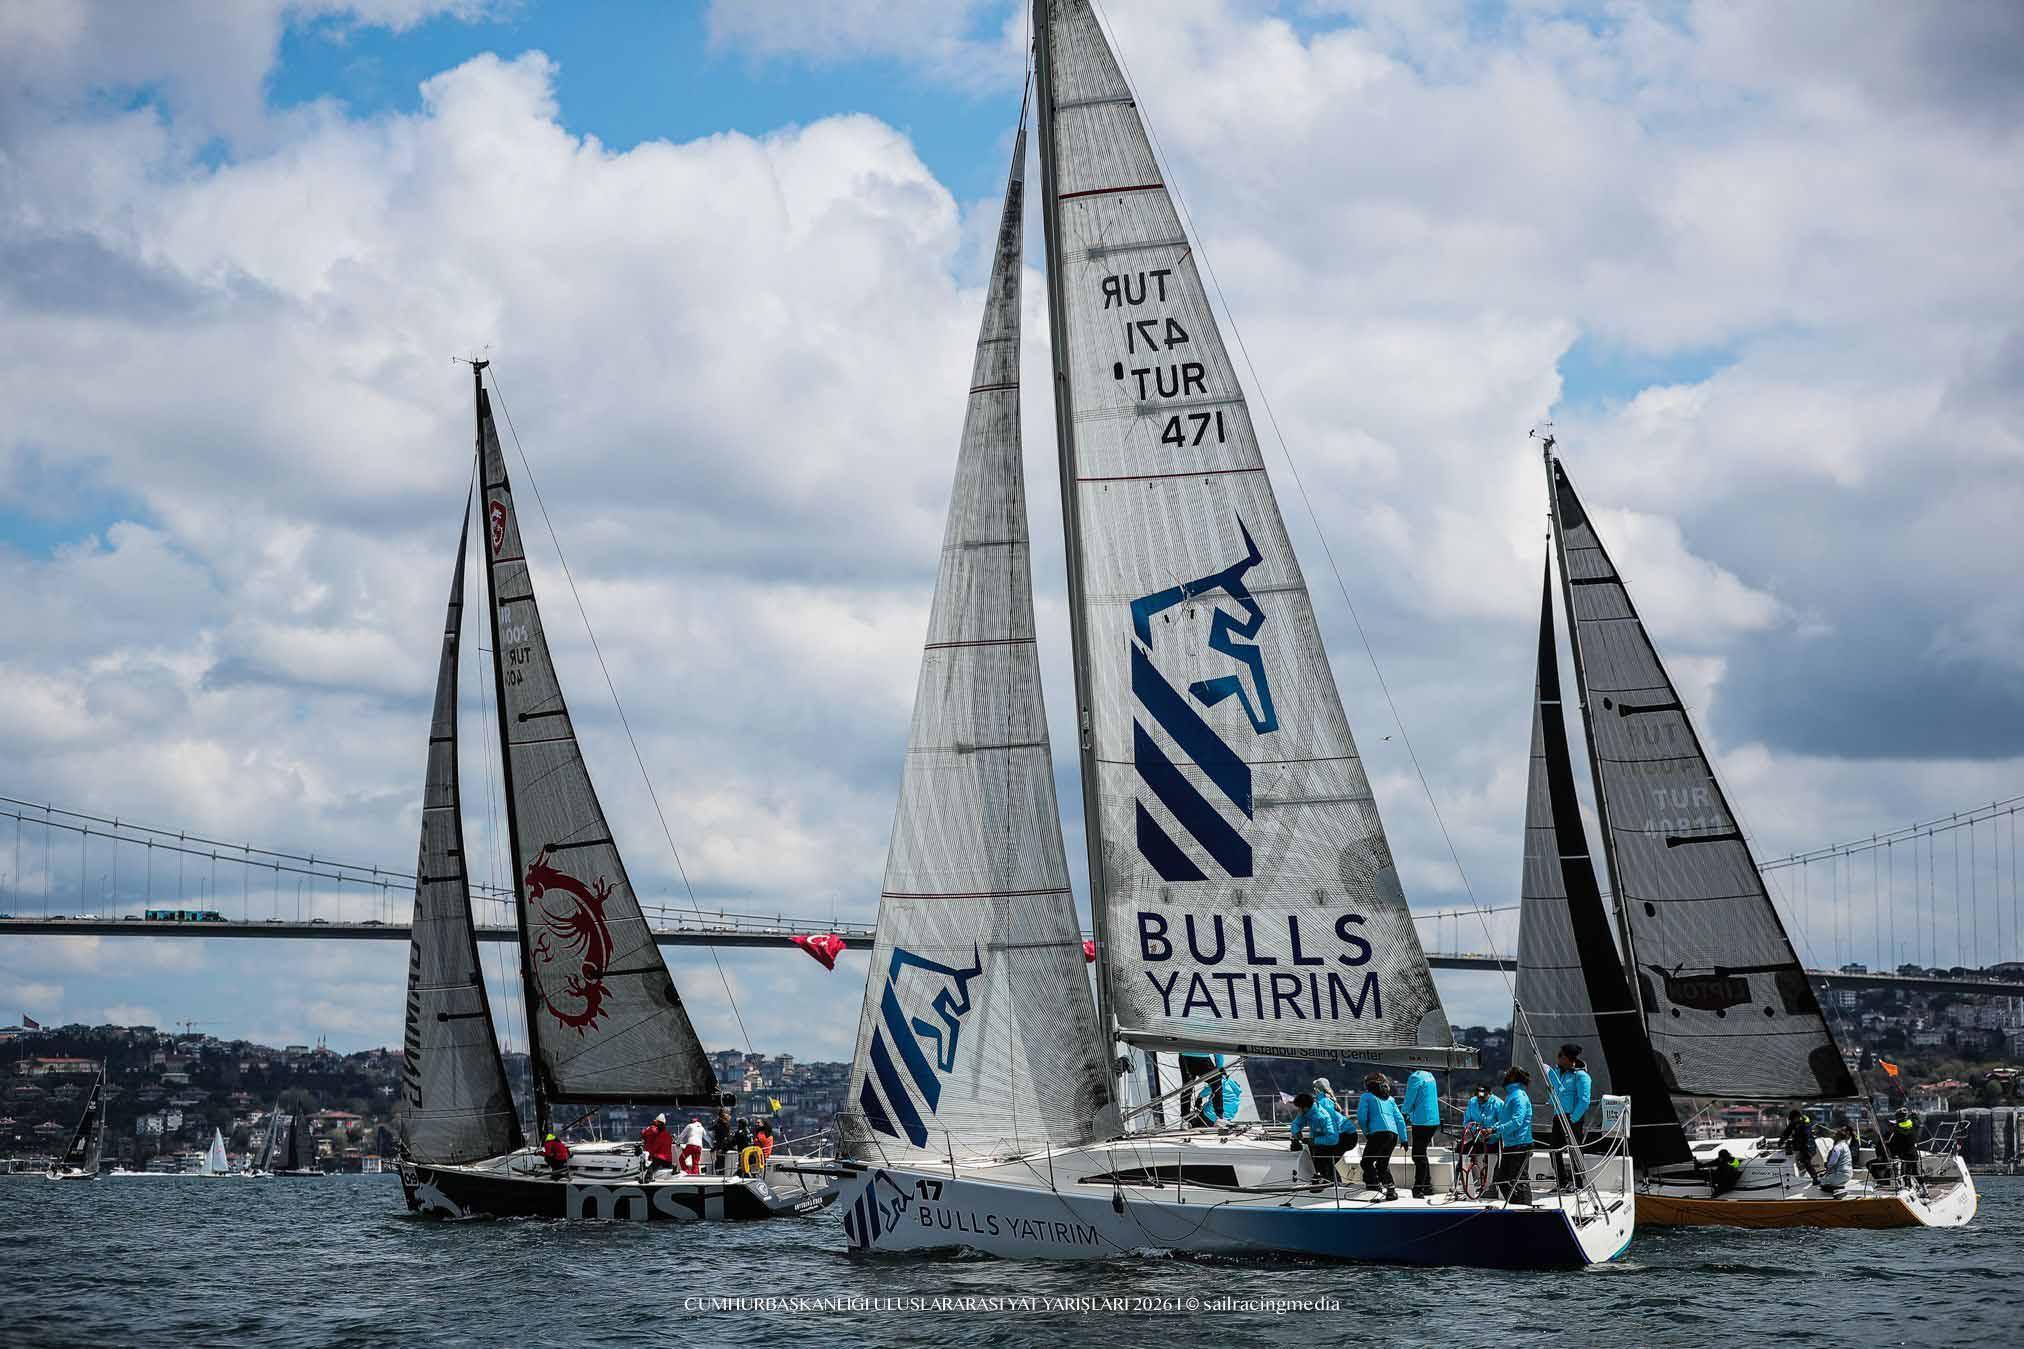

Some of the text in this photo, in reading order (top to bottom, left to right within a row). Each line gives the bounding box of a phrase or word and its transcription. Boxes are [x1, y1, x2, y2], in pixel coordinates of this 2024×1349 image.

[1131, 363, 1207, 400] TUR
[1161, 411, 1225, 447] 471
[1652, 784, 1710, 810] TUR
[1137, 911, 1373, 967] BULLS
[1145, 971, 1383, 1020] YATIRIM
[1341, 1048, 1384, 1061] Center
[916, 1179, 943, 1200] 17
[919, 1206, 1099, 1246] BULLS YATIRIM
